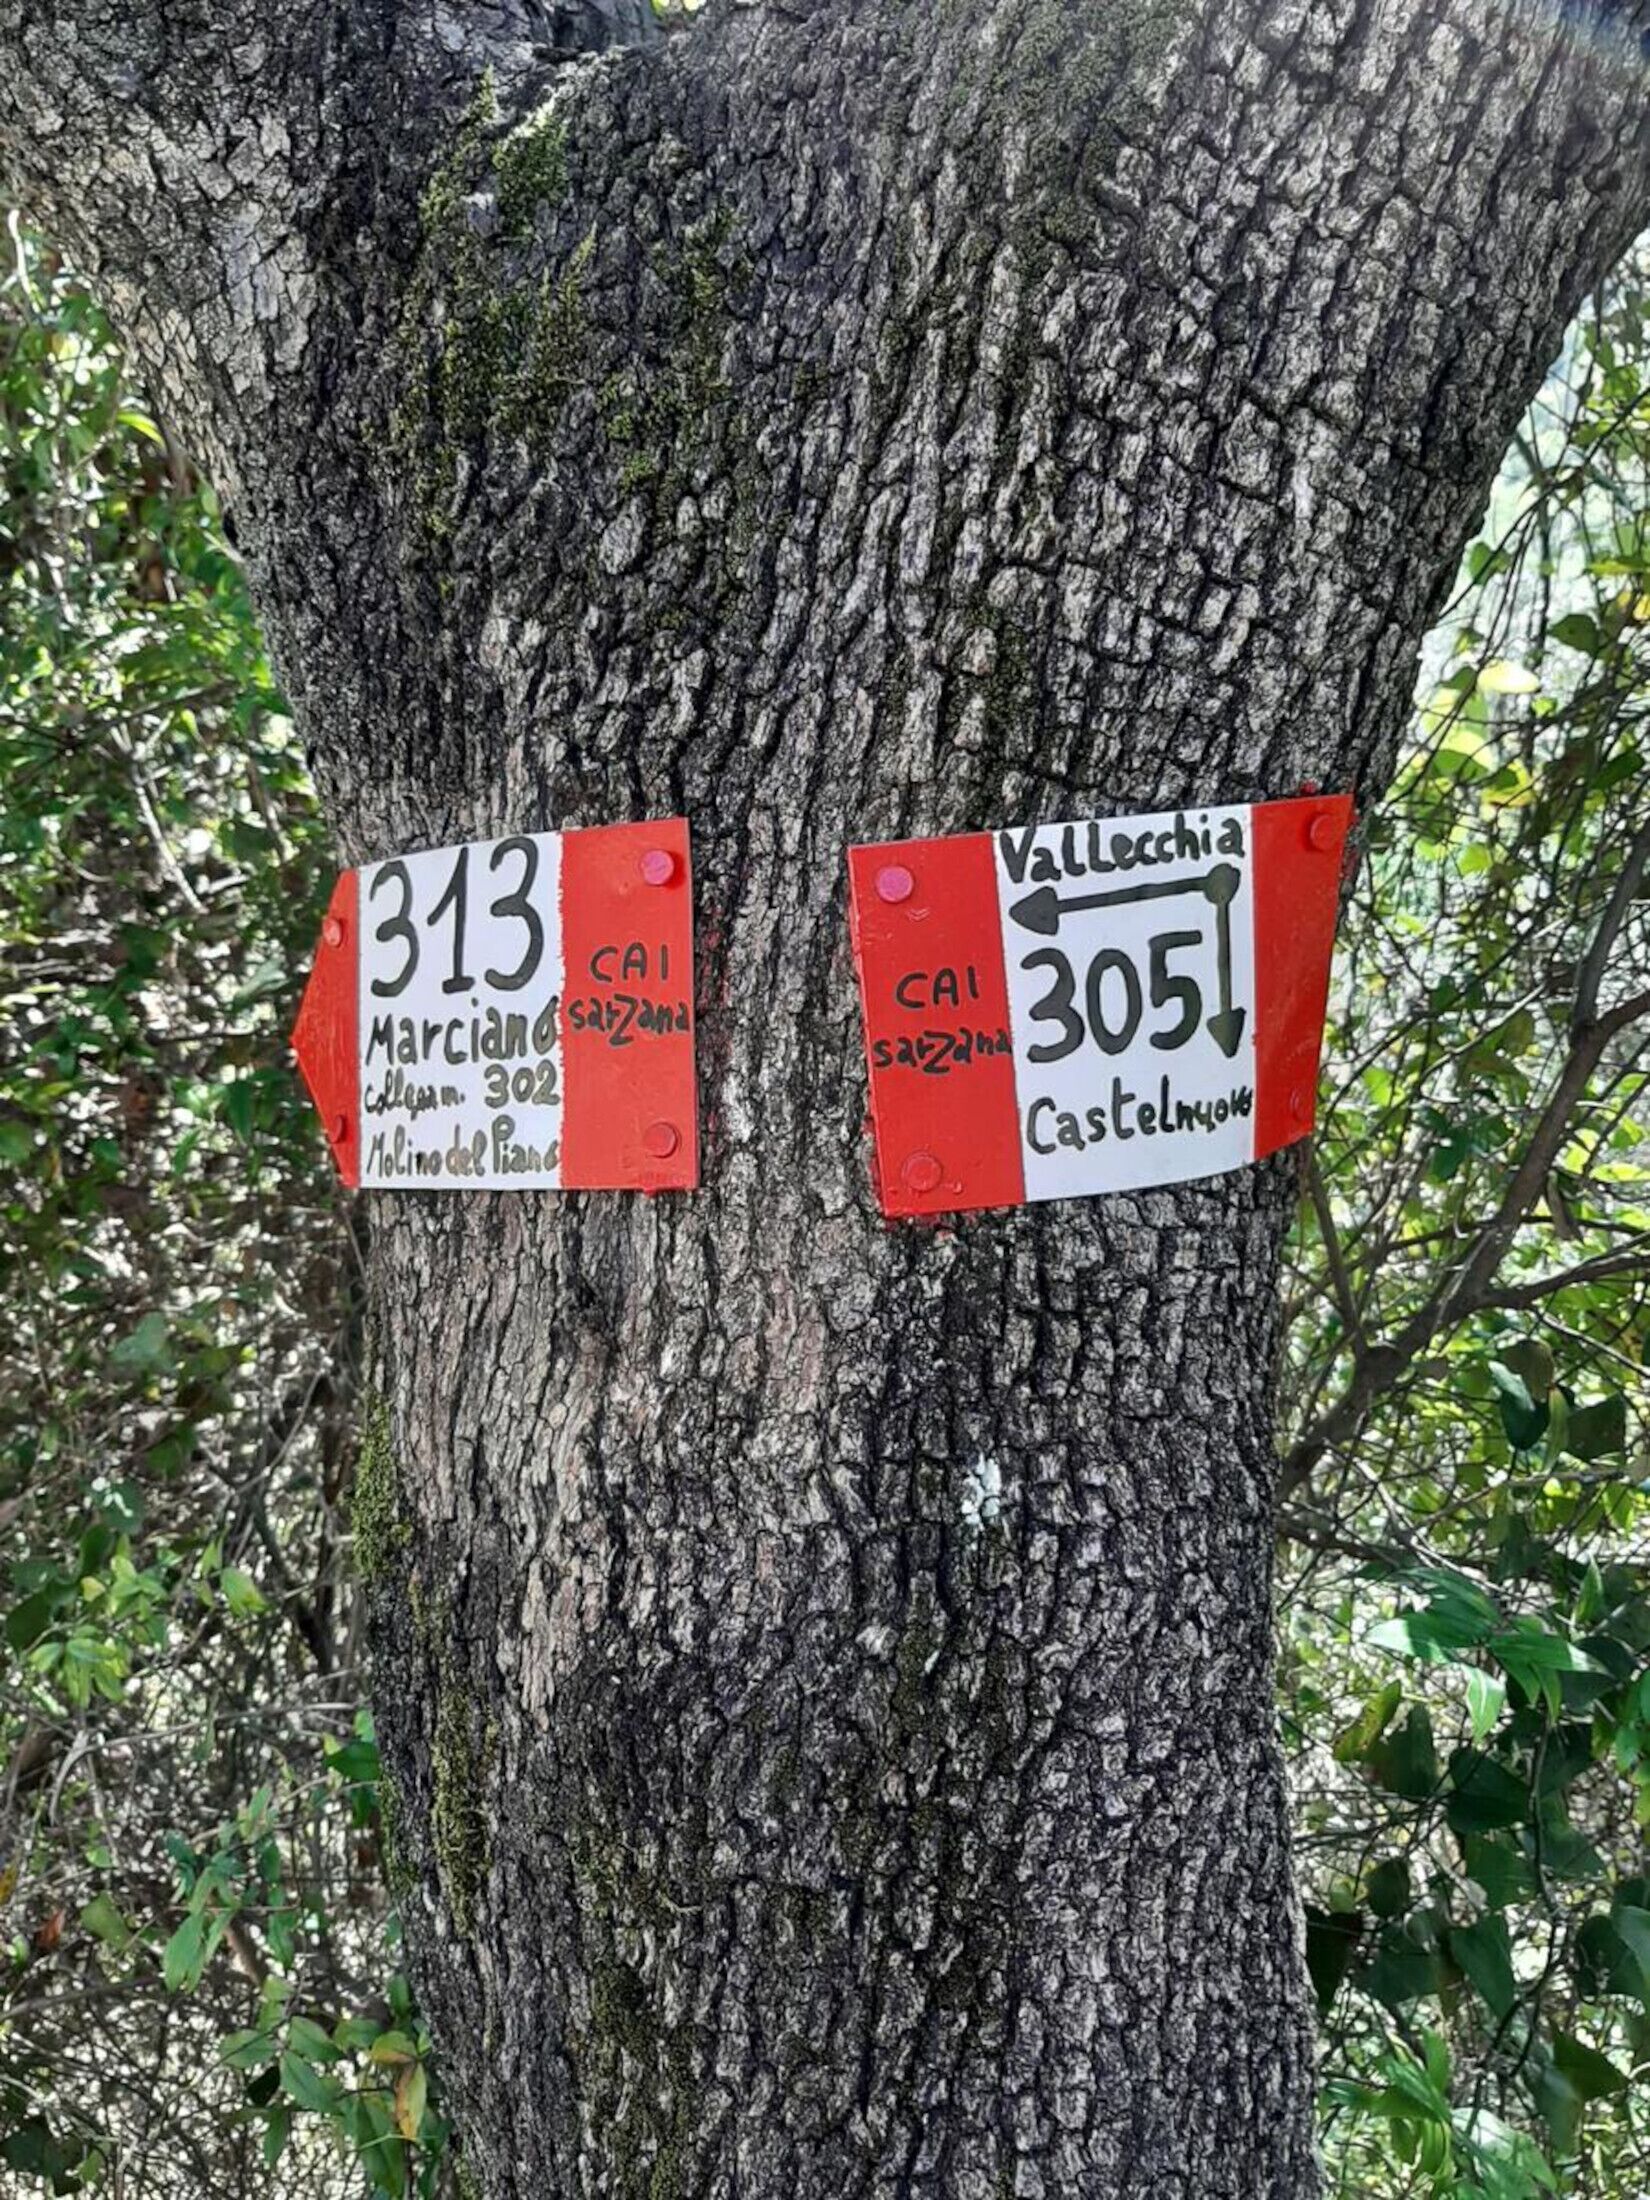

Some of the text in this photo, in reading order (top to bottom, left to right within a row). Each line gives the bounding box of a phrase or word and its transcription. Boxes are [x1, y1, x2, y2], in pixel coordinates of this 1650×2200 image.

[1000, 813, 1245, 884] Vallecchia
[369, 835, 544, 997] 313
[590, 941, 669, 983] CAI
[895, 965, 980, 1010] CAI
[1020, 930, 1204, 1064] 305
[365, 995, 561, 1067] Marciano
[484, 1058, 561, 1109] 302
